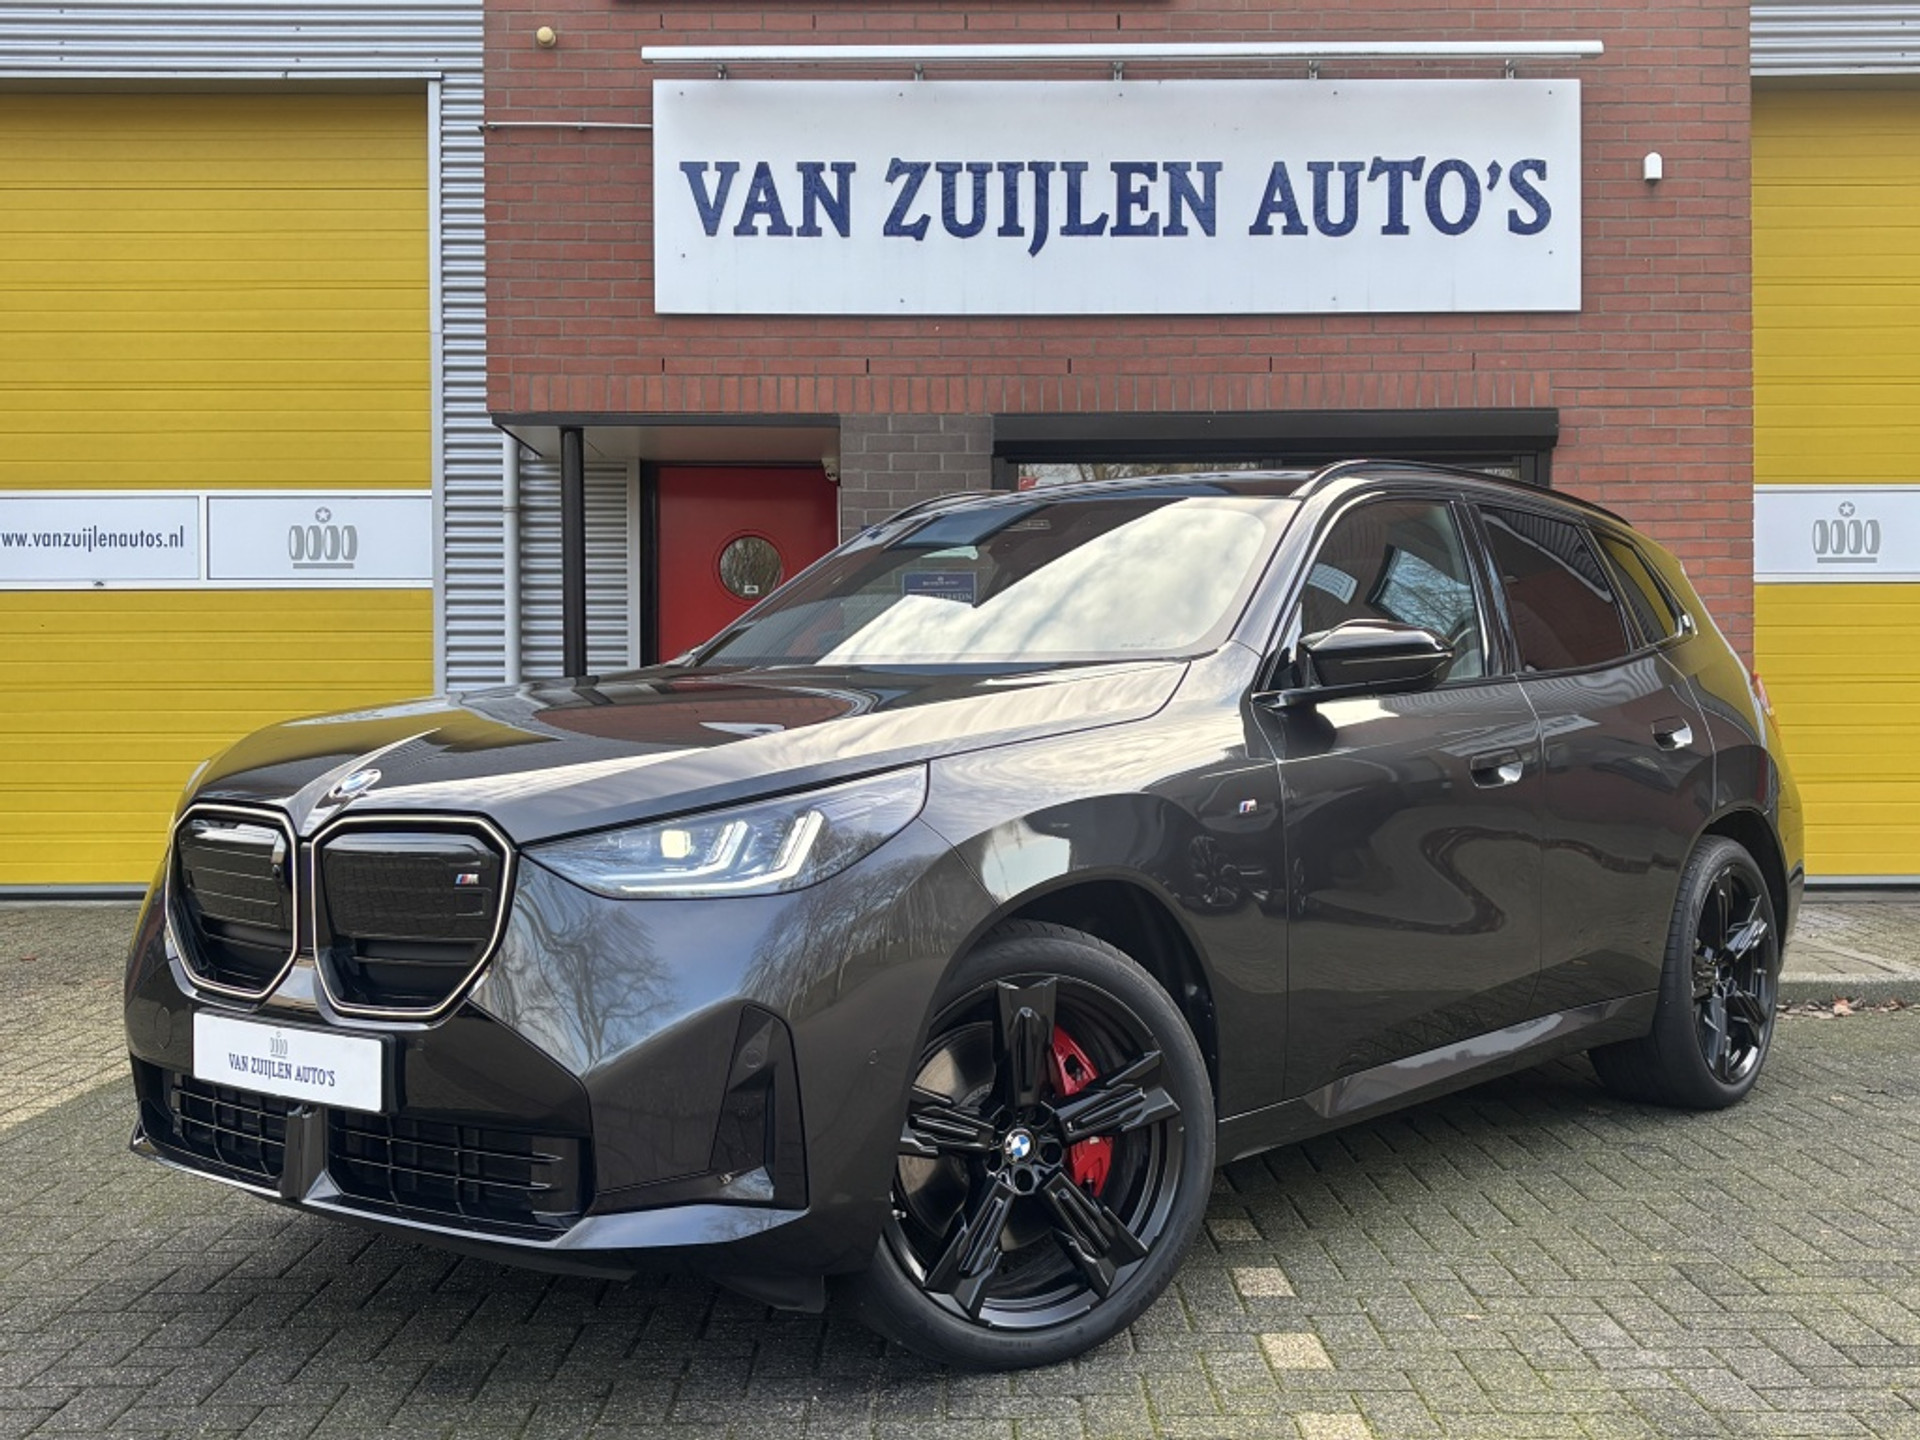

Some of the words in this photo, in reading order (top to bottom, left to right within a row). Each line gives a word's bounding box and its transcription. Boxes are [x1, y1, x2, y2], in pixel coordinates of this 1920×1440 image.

[679, 161, 857, 238] VAN
[881, 157, 1224, 258] ZUIJLEN
[1248, 156, 1552, 239] AUTO'S
[0, 524, 185, 553] ww.vanzuijlenautos.nl
[228, 1053, 249, 1073] VAN
[251, 1056, 293, 1081] ZUIJLEN
[294, 1064, 336, 1087] AUTO'S
